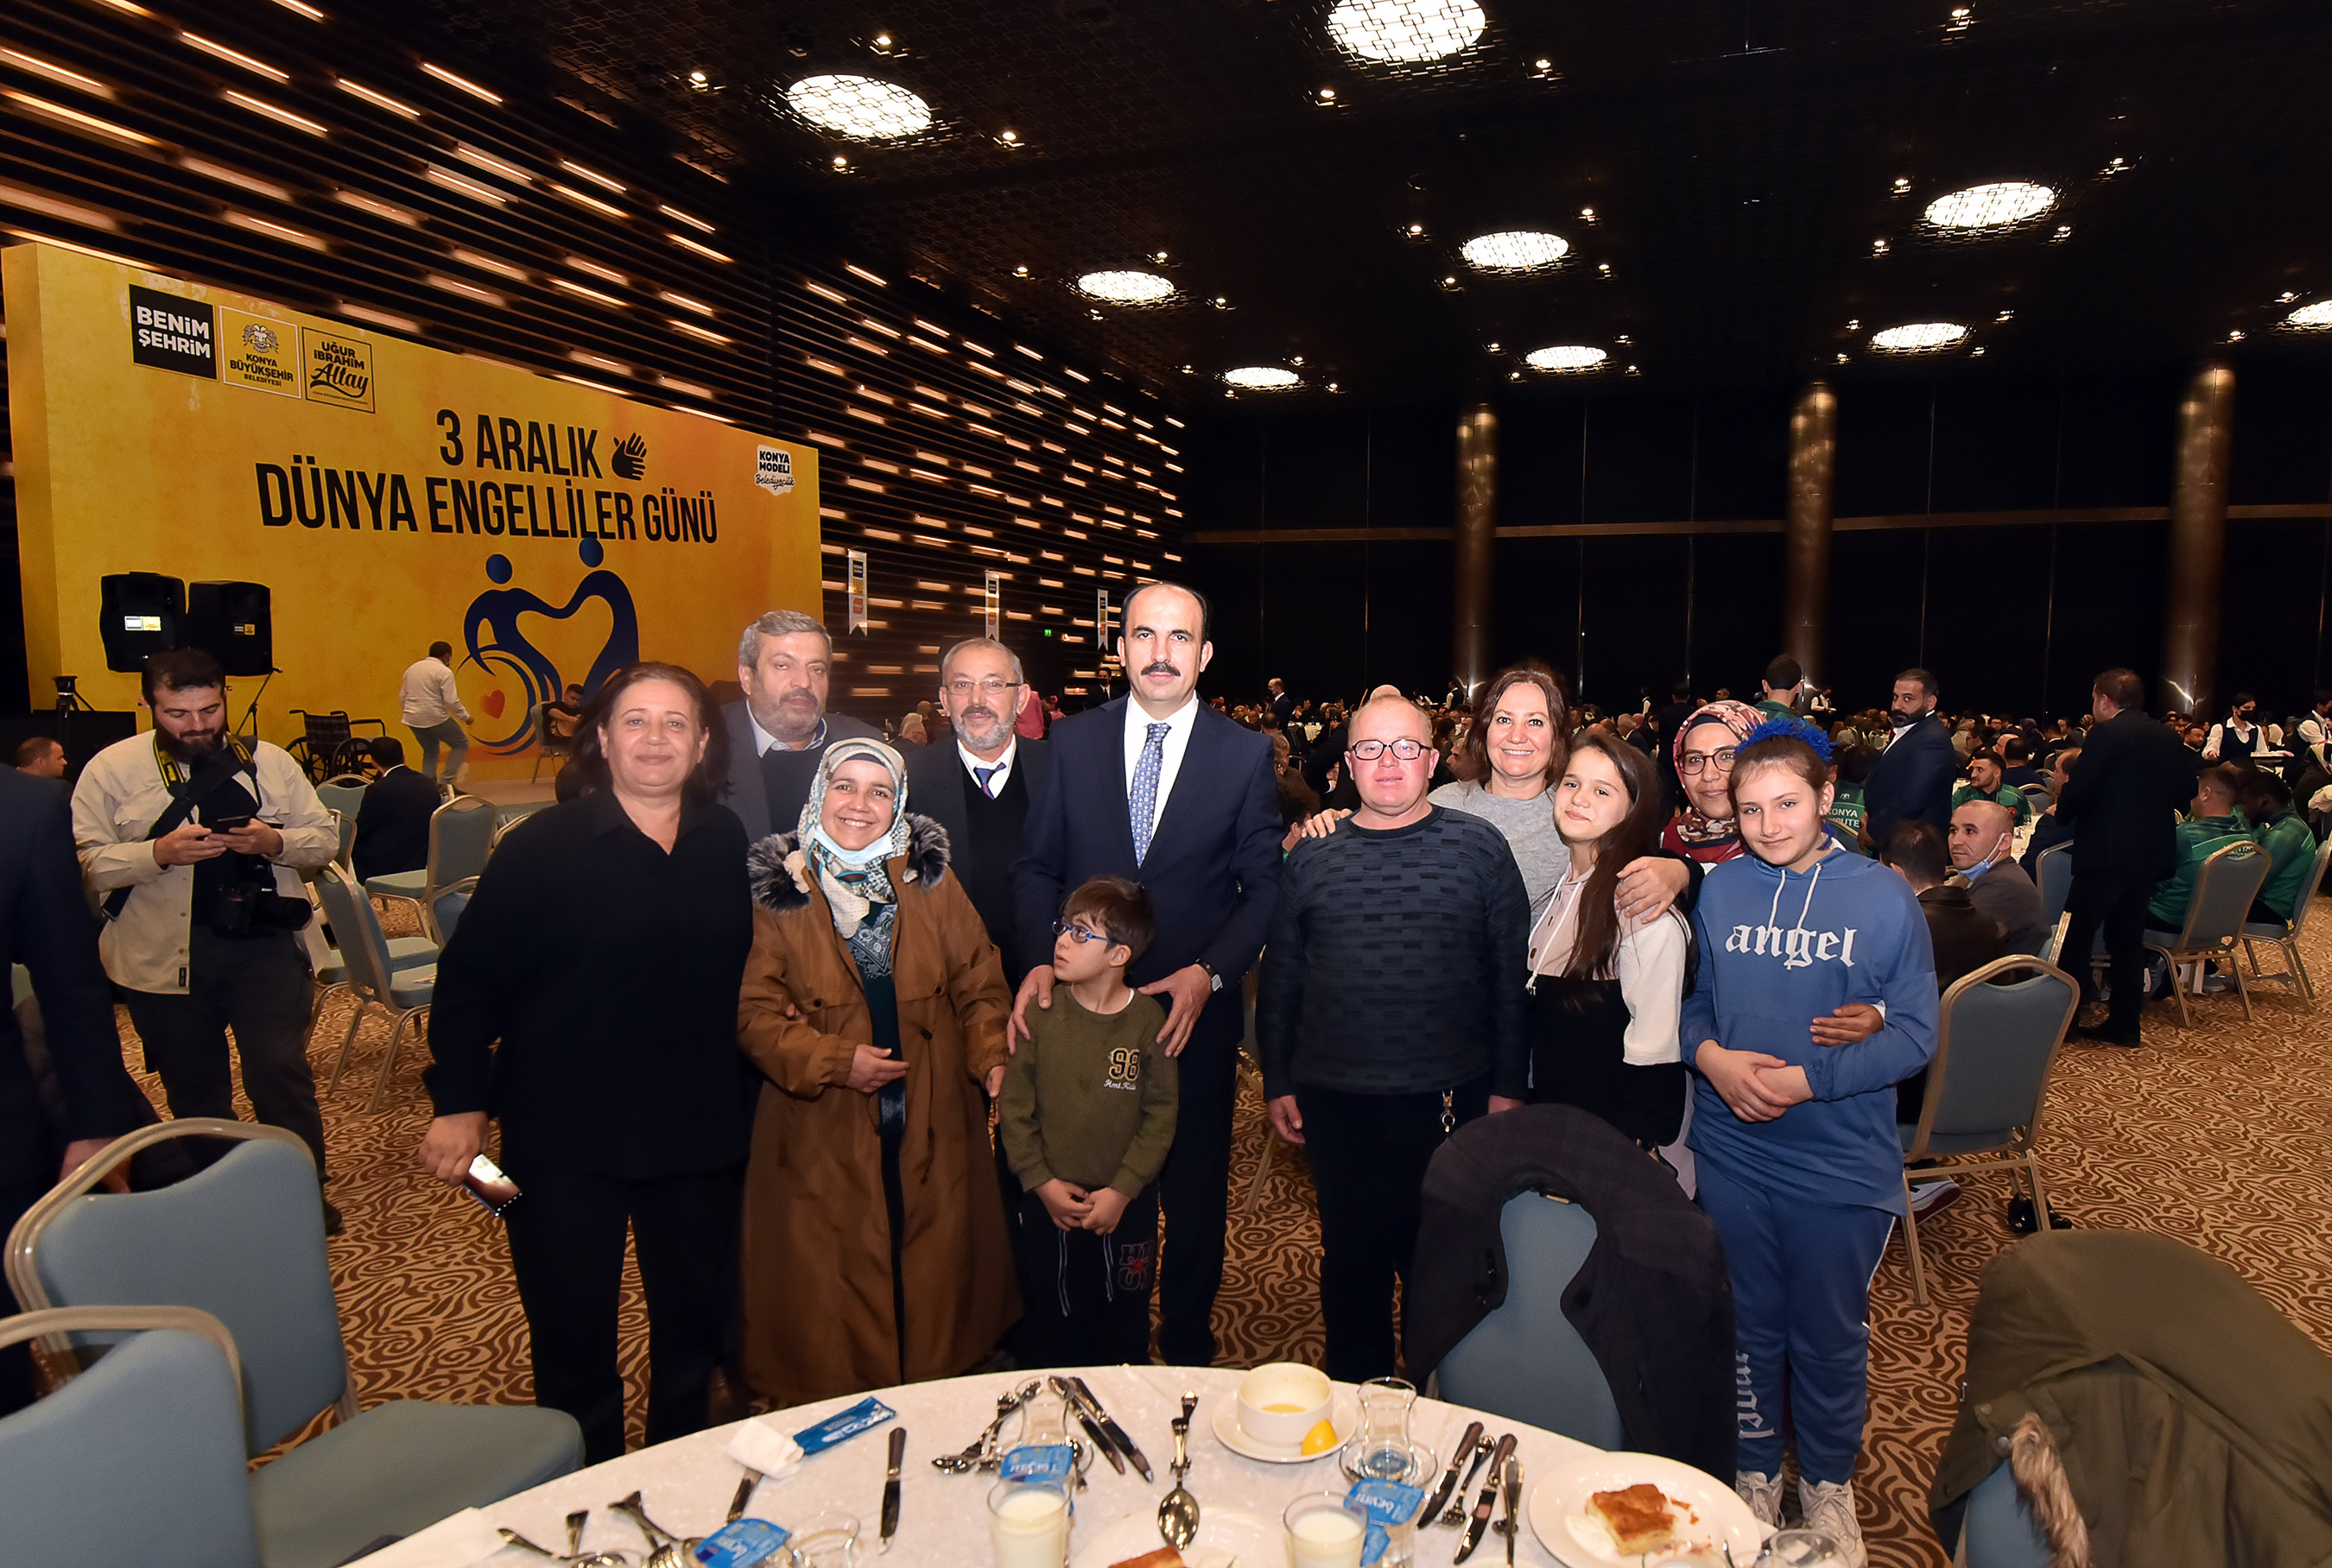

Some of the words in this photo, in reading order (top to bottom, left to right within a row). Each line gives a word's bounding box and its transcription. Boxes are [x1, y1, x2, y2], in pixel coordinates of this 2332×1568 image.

[245, 353, 277, 367] KONYA
[321, 341, 356, 358] UĞUR
[230, 359, 294, 383] BÜYÜKŞEHİR
[244, 374, 282, 387] BELEDİYESİ
[310, 363, 369, 398] Altay
[436, 408, 464, 465] 3
[476, 414, 603, 479] ARALIK
[759, 451, 789, 464] KONYA
[255, 454, 419, 532] DÜNYA
[425, 478, 637, 541] ENGELLİLER
[642, 487, 718, 544] GÜNÜ
[1725, 925, 1858, 970] angel
[1109, 1047, 1140, 1081] 98
